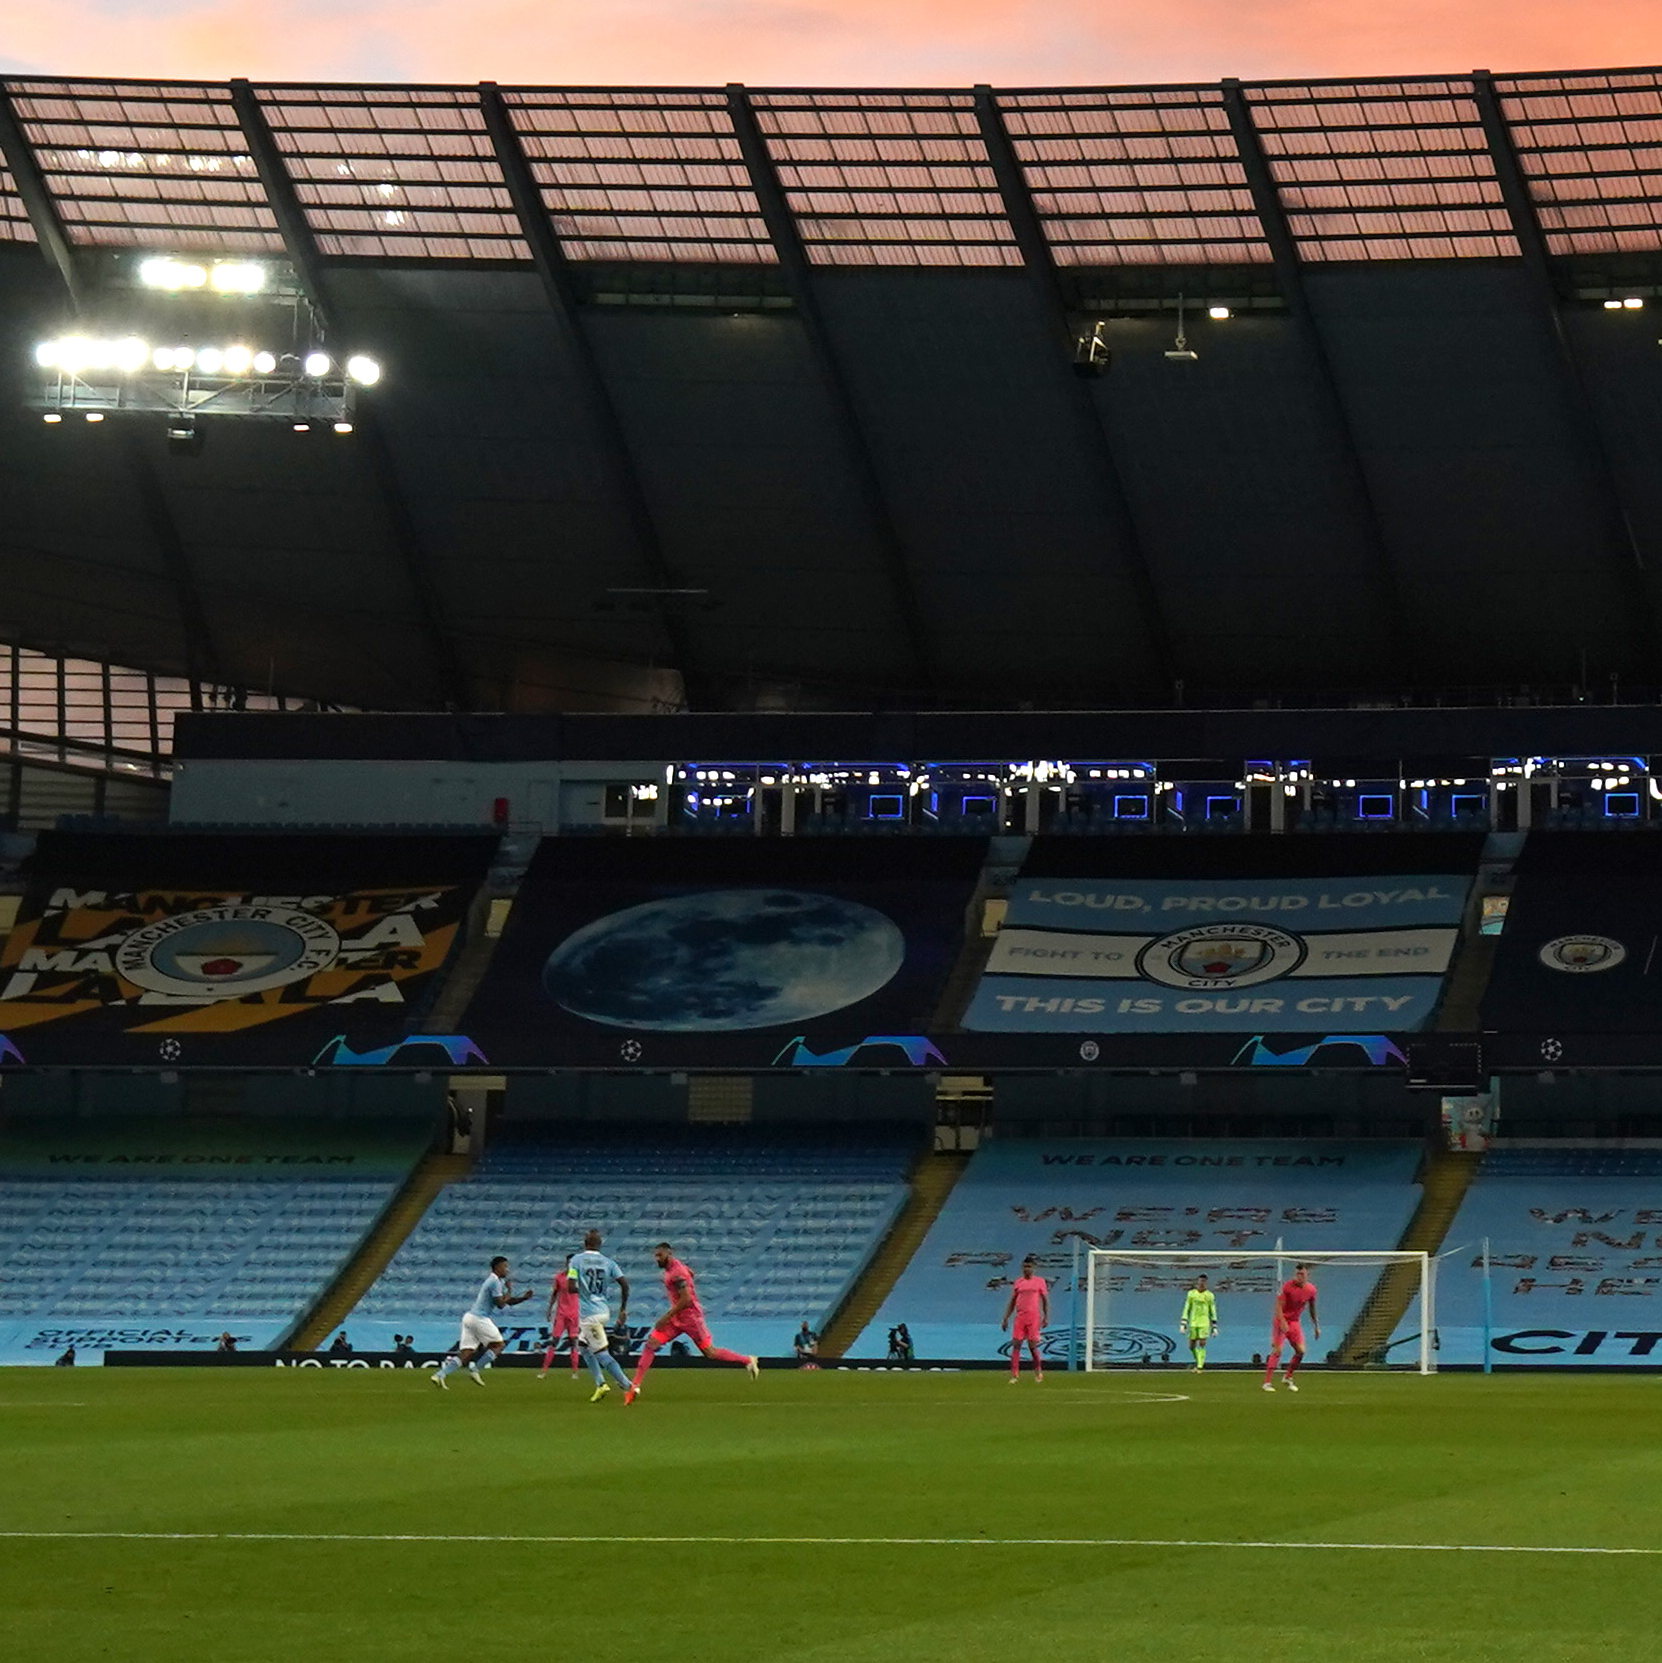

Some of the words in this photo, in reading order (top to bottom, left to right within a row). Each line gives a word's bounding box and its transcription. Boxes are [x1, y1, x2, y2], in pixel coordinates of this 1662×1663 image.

[1028, 890, 1152, 914] LOUD,
[1160, 894, 1309, 912] PROUD
[1317, 886, 1452, 909] LOYAL
[122, 907, 272, 972] MANCHESTER
[286, 915, 332, 940] CITY
[1160, 925, 1291, 950] MANCHESTER
[1008, 946, 1082, 960] FIGHT
[1090, 951, 1125, 961] TO
[1322, 949, 1369, 960] THE
[1378, 946, 1430, 957] END
[1188, 978, 1238, 987] CITY
[995, 995, 1105, 1014] THIS
[1117, 998, 1163, 1014] IS
[1174, 997, 1286, 1014] OUR
[1295, 995, 1415, 1013] CITY
[107, 1154, 177, 1165] ARE
[182, 1154, 253, 1165] ONE
[263, 1154, 356, 1165] TEAM
[1041, 1154, 1095, 1166] WE
[1101, 1154, 1163, 1166] ARE
[1173, 1154, 1246, 1166] ONE
[1256, 1154, 1346, 1166] TEAM
[1011, 1206, 1339, 1223] WE'RE
[1050, 1229, 1269, 1248] NOT
[585, 1268, 606, 1295] 25
[38, 1328, 194, 1337] OFFICIAL
